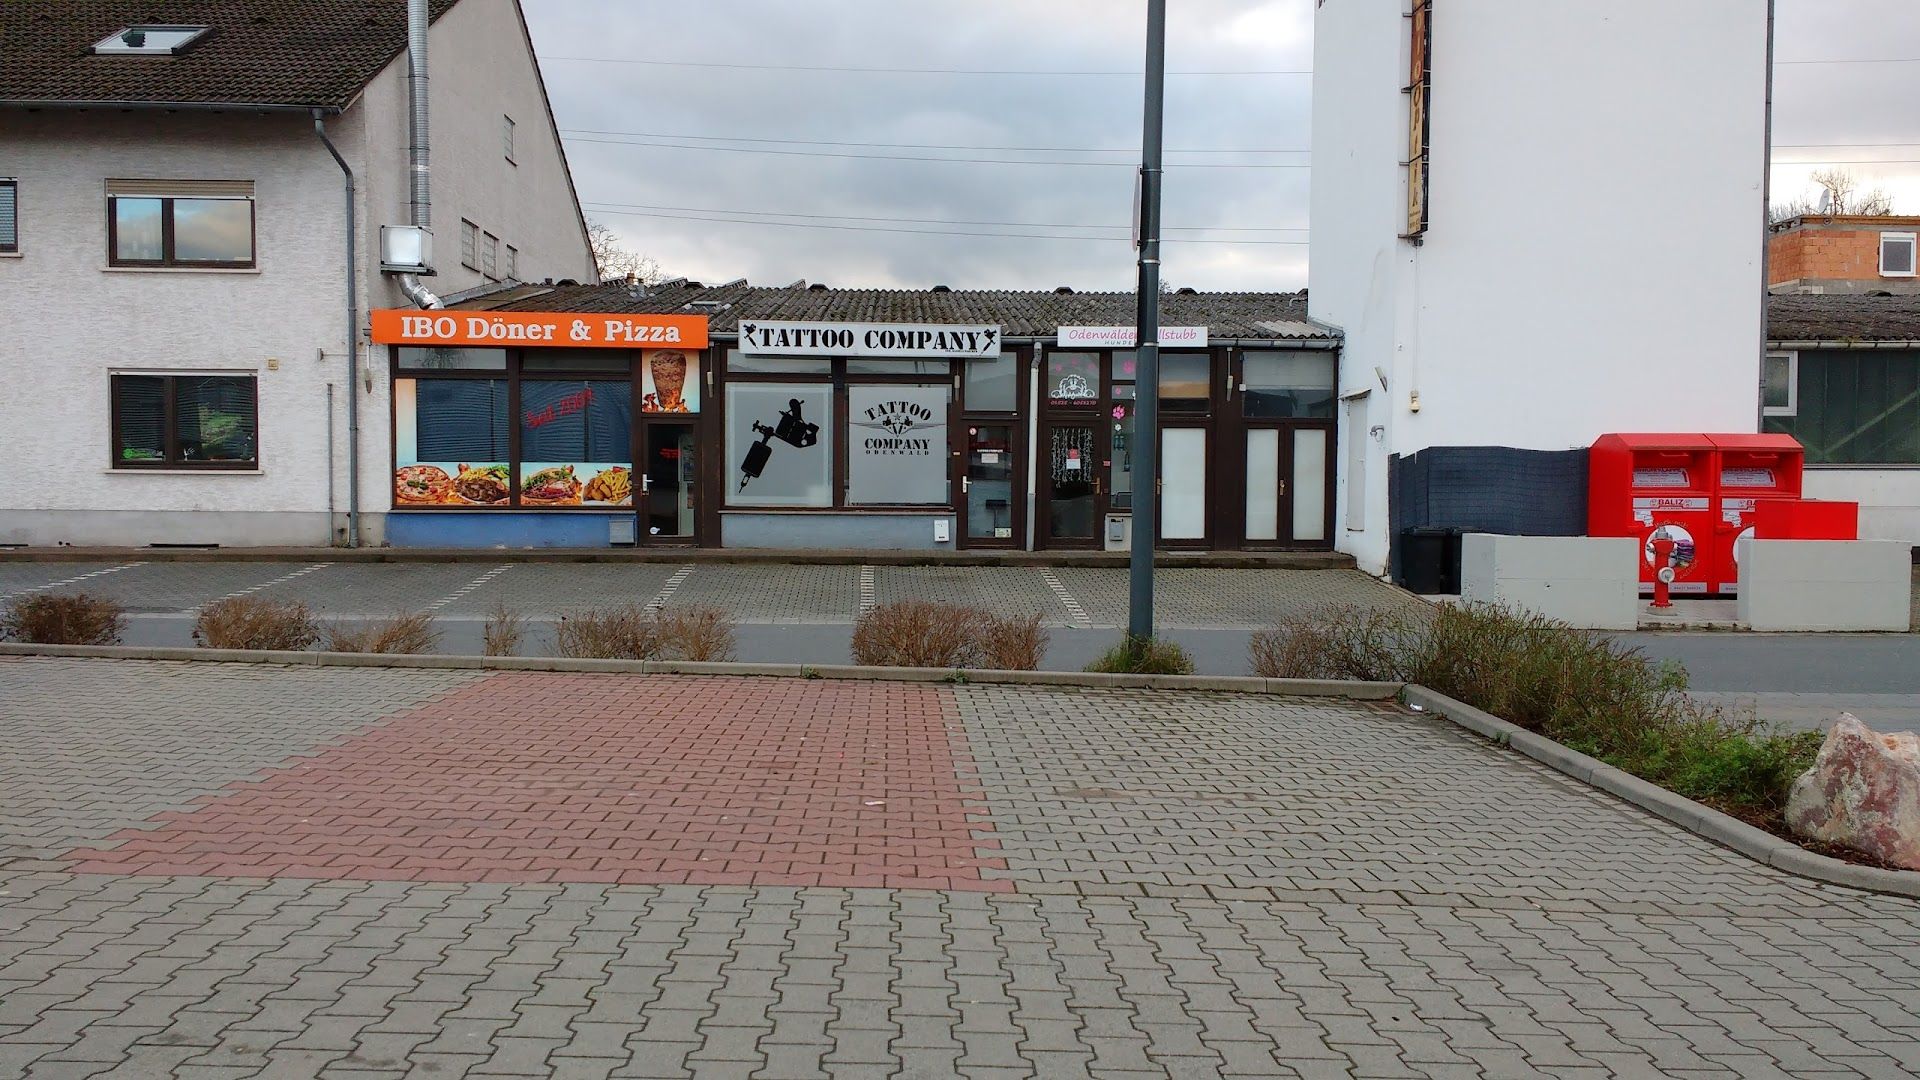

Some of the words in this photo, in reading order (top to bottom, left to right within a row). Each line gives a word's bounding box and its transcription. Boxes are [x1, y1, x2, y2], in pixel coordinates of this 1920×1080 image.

[400, 317, 457, 338] IBO
[465, 318, 556, 341] Döner
[569, 320, 592, 341] &
[604, 320, 682, 343] Pizza
[759, 328, 854, 348] TATTOO
[864, 329, 981, 351] COMPANY
[864, 400, 931, 421] TATTOO
[864, 438, 930, 450] COMPANY
